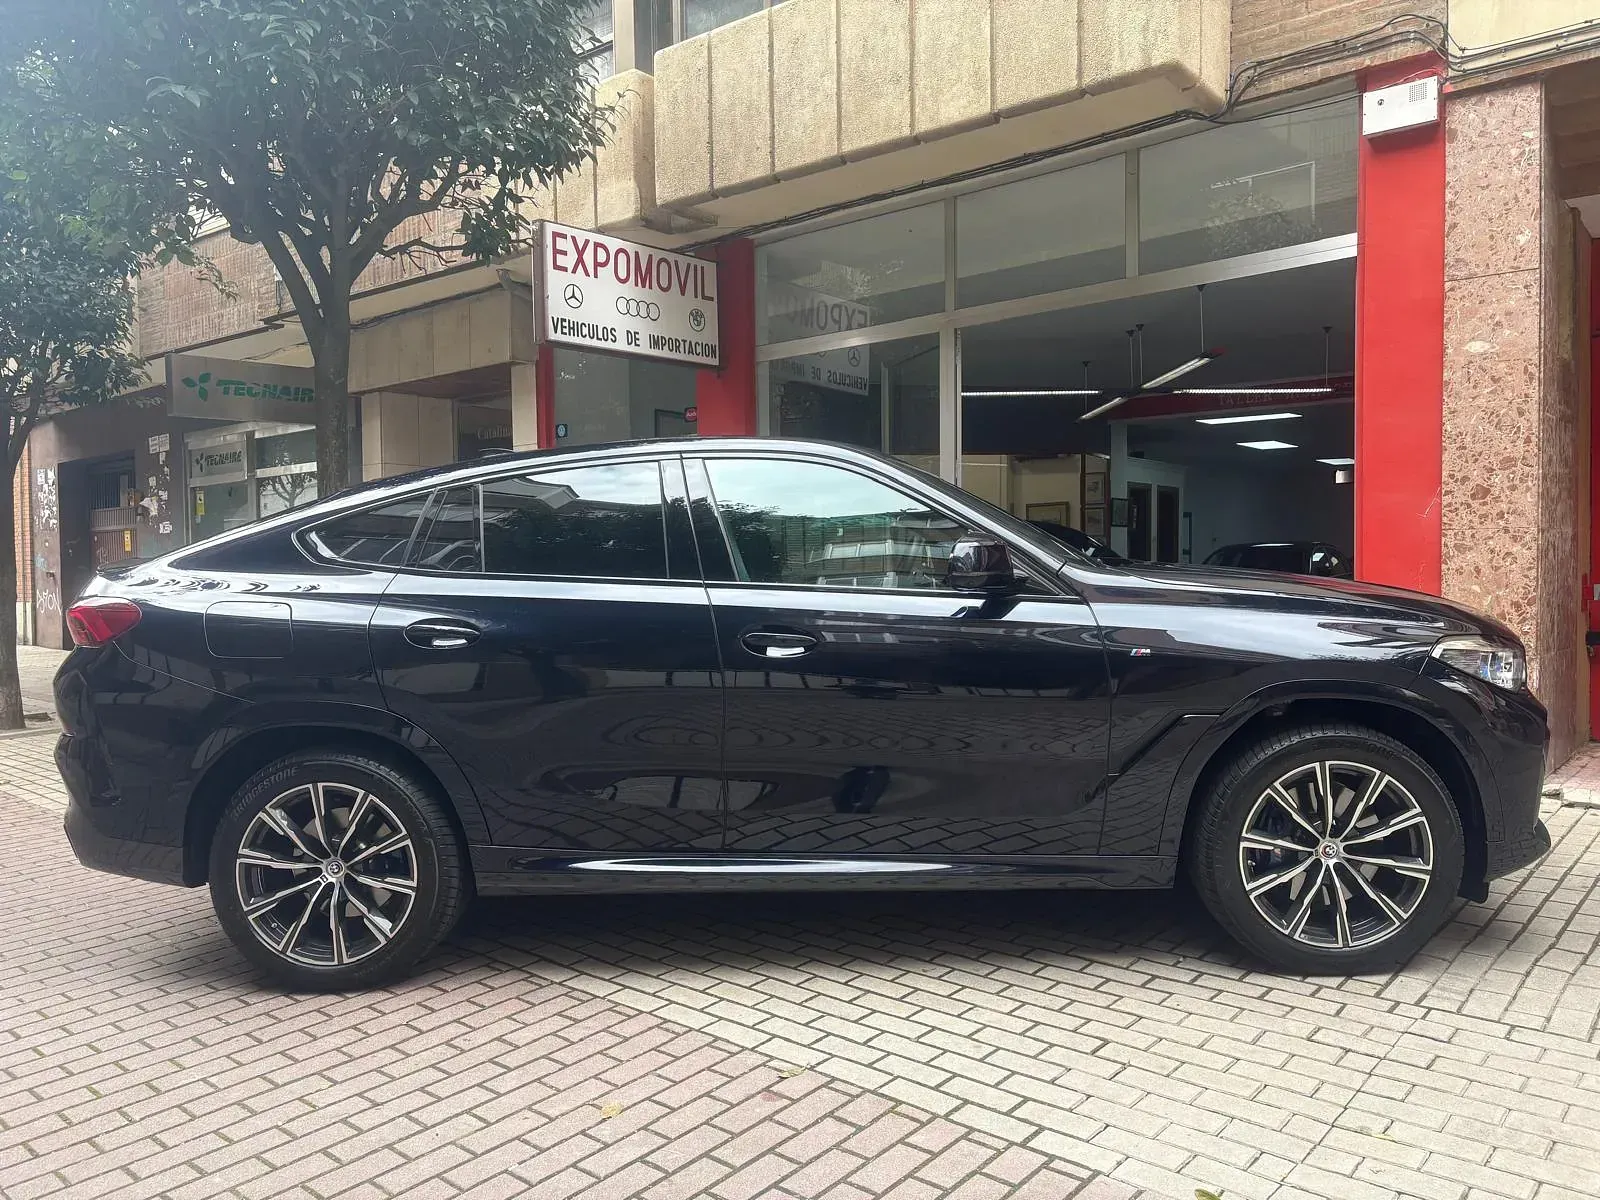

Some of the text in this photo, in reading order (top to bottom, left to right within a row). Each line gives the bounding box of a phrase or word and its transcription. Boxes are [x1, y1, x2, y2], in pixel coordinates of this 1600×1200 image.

[551, 231, 714, 301] EXPOMOVIL
[551, 316, 717, 359] VEHICULOS DE IMPORTACION
[216, 379, 314, 402] TECNAIR
[204, 451, 242, 466] TECNAIRE
